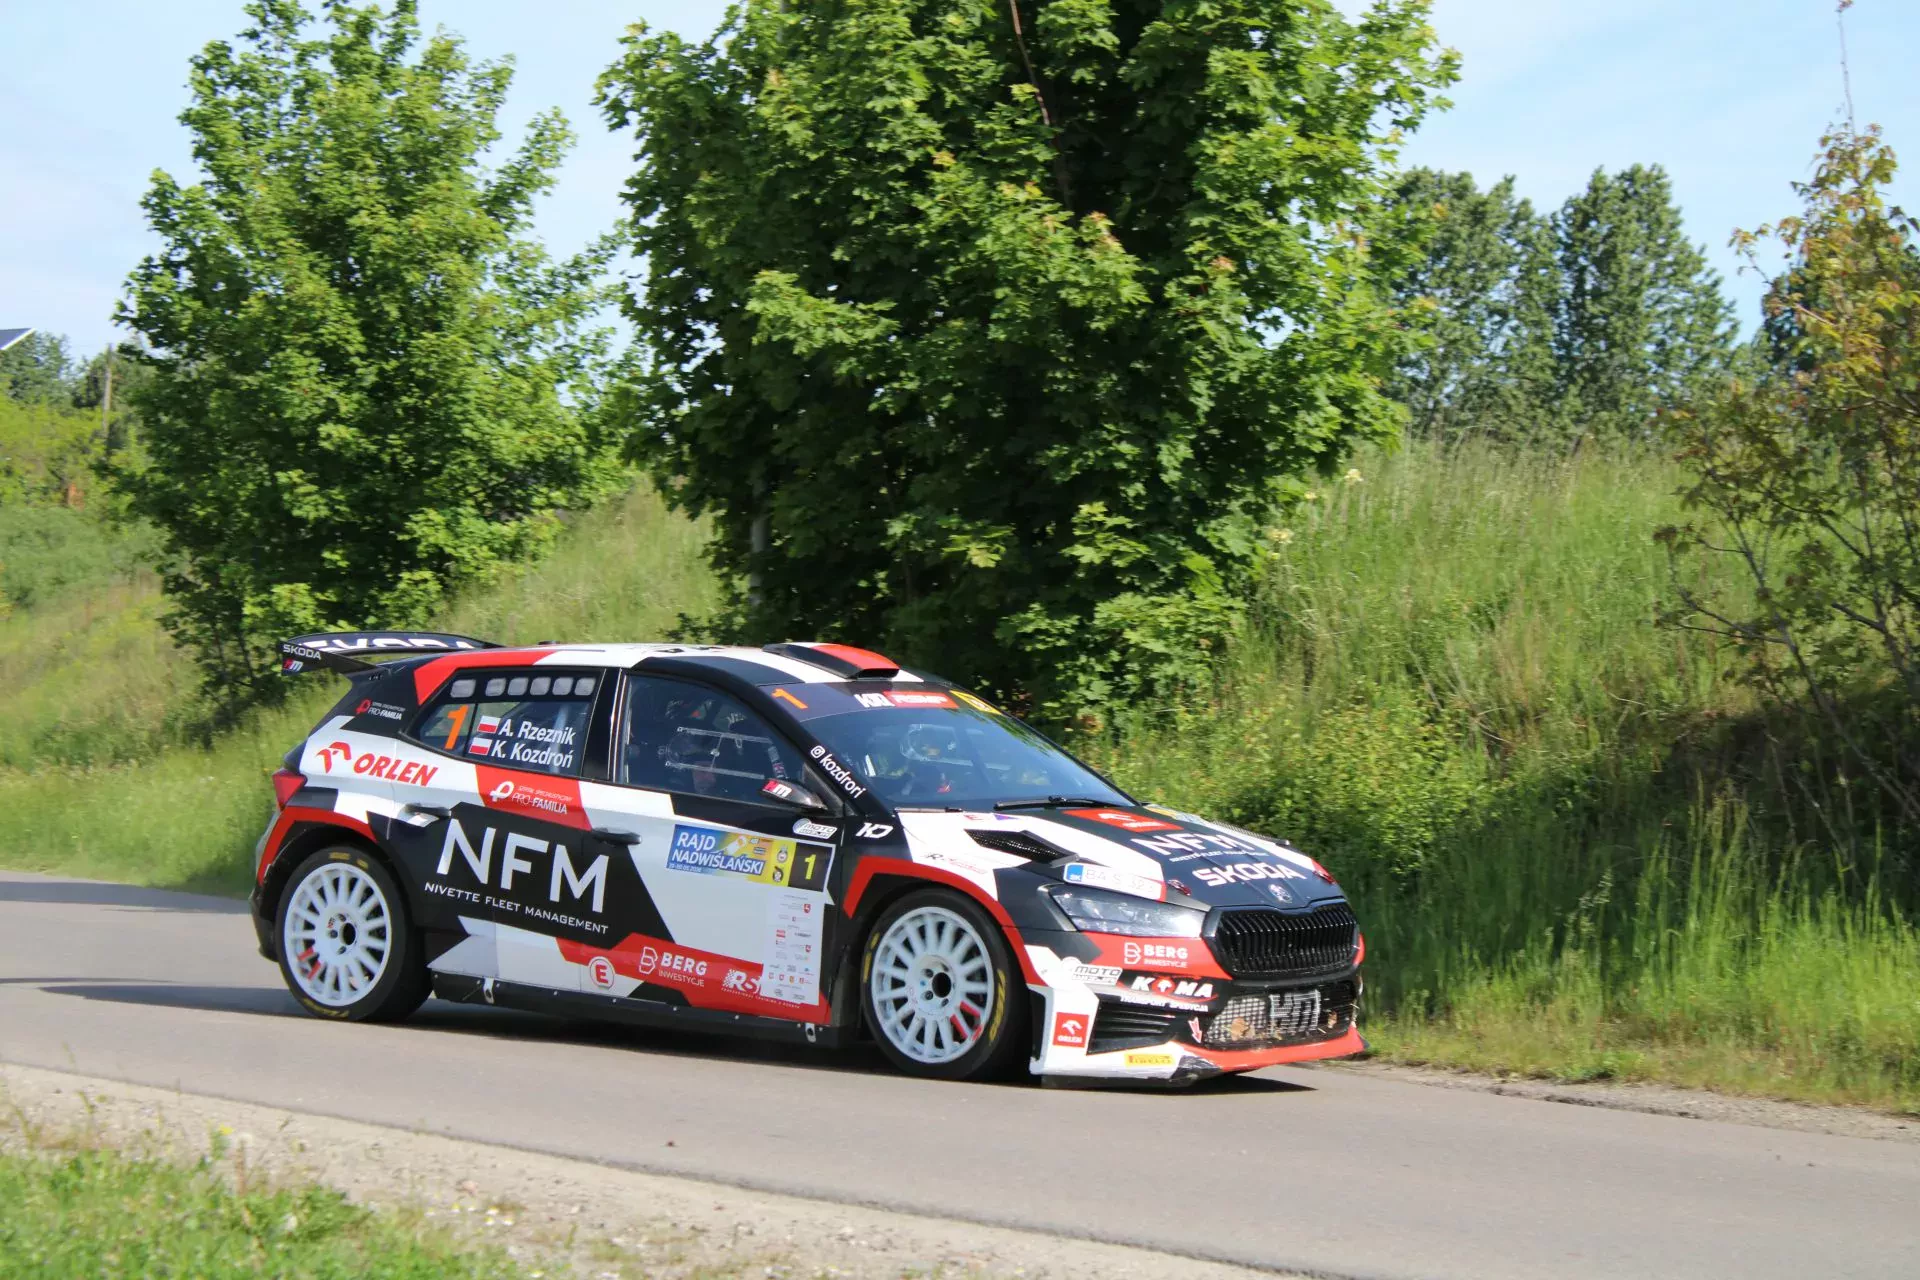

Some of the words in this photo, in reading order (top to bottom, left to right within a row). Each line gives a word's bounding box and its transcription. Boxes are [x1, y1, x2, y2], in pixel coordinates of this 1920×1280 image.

[771, 688, 809, 709] 1
[444, 703, 469, 750] 1
[498, 718, 514, 738] A.
[517, 720, 576, 745] Rzeznik
[491, 740, 507, 759] K.
[510, 742, 574, 769] Kozdroń
[353, 752, 439, 787] ORLEN
[512, 792, 568, 815] PRO-FAMILIA
[677, 831, 716, 852] RAJD
[1130, 832, 1257, 856] NFM
[436, 818, 610, 913] NFM
[671, 848, 765, 875] NADWIŚLAŃSKI
[804, 854, 817, 880] 1
[424, 882, 481, 903] NIVETTE
[485, 896, 521, 912] FLEET
[525, 905, 609, 935] MANAGEMENT
[660, 952, 708, 976] BERG
[1143, 944, 1188, 959] BERG
[658, 969, 705, 988] INWESTYCJE
[1074, 965, 1121, 976] MOTO
